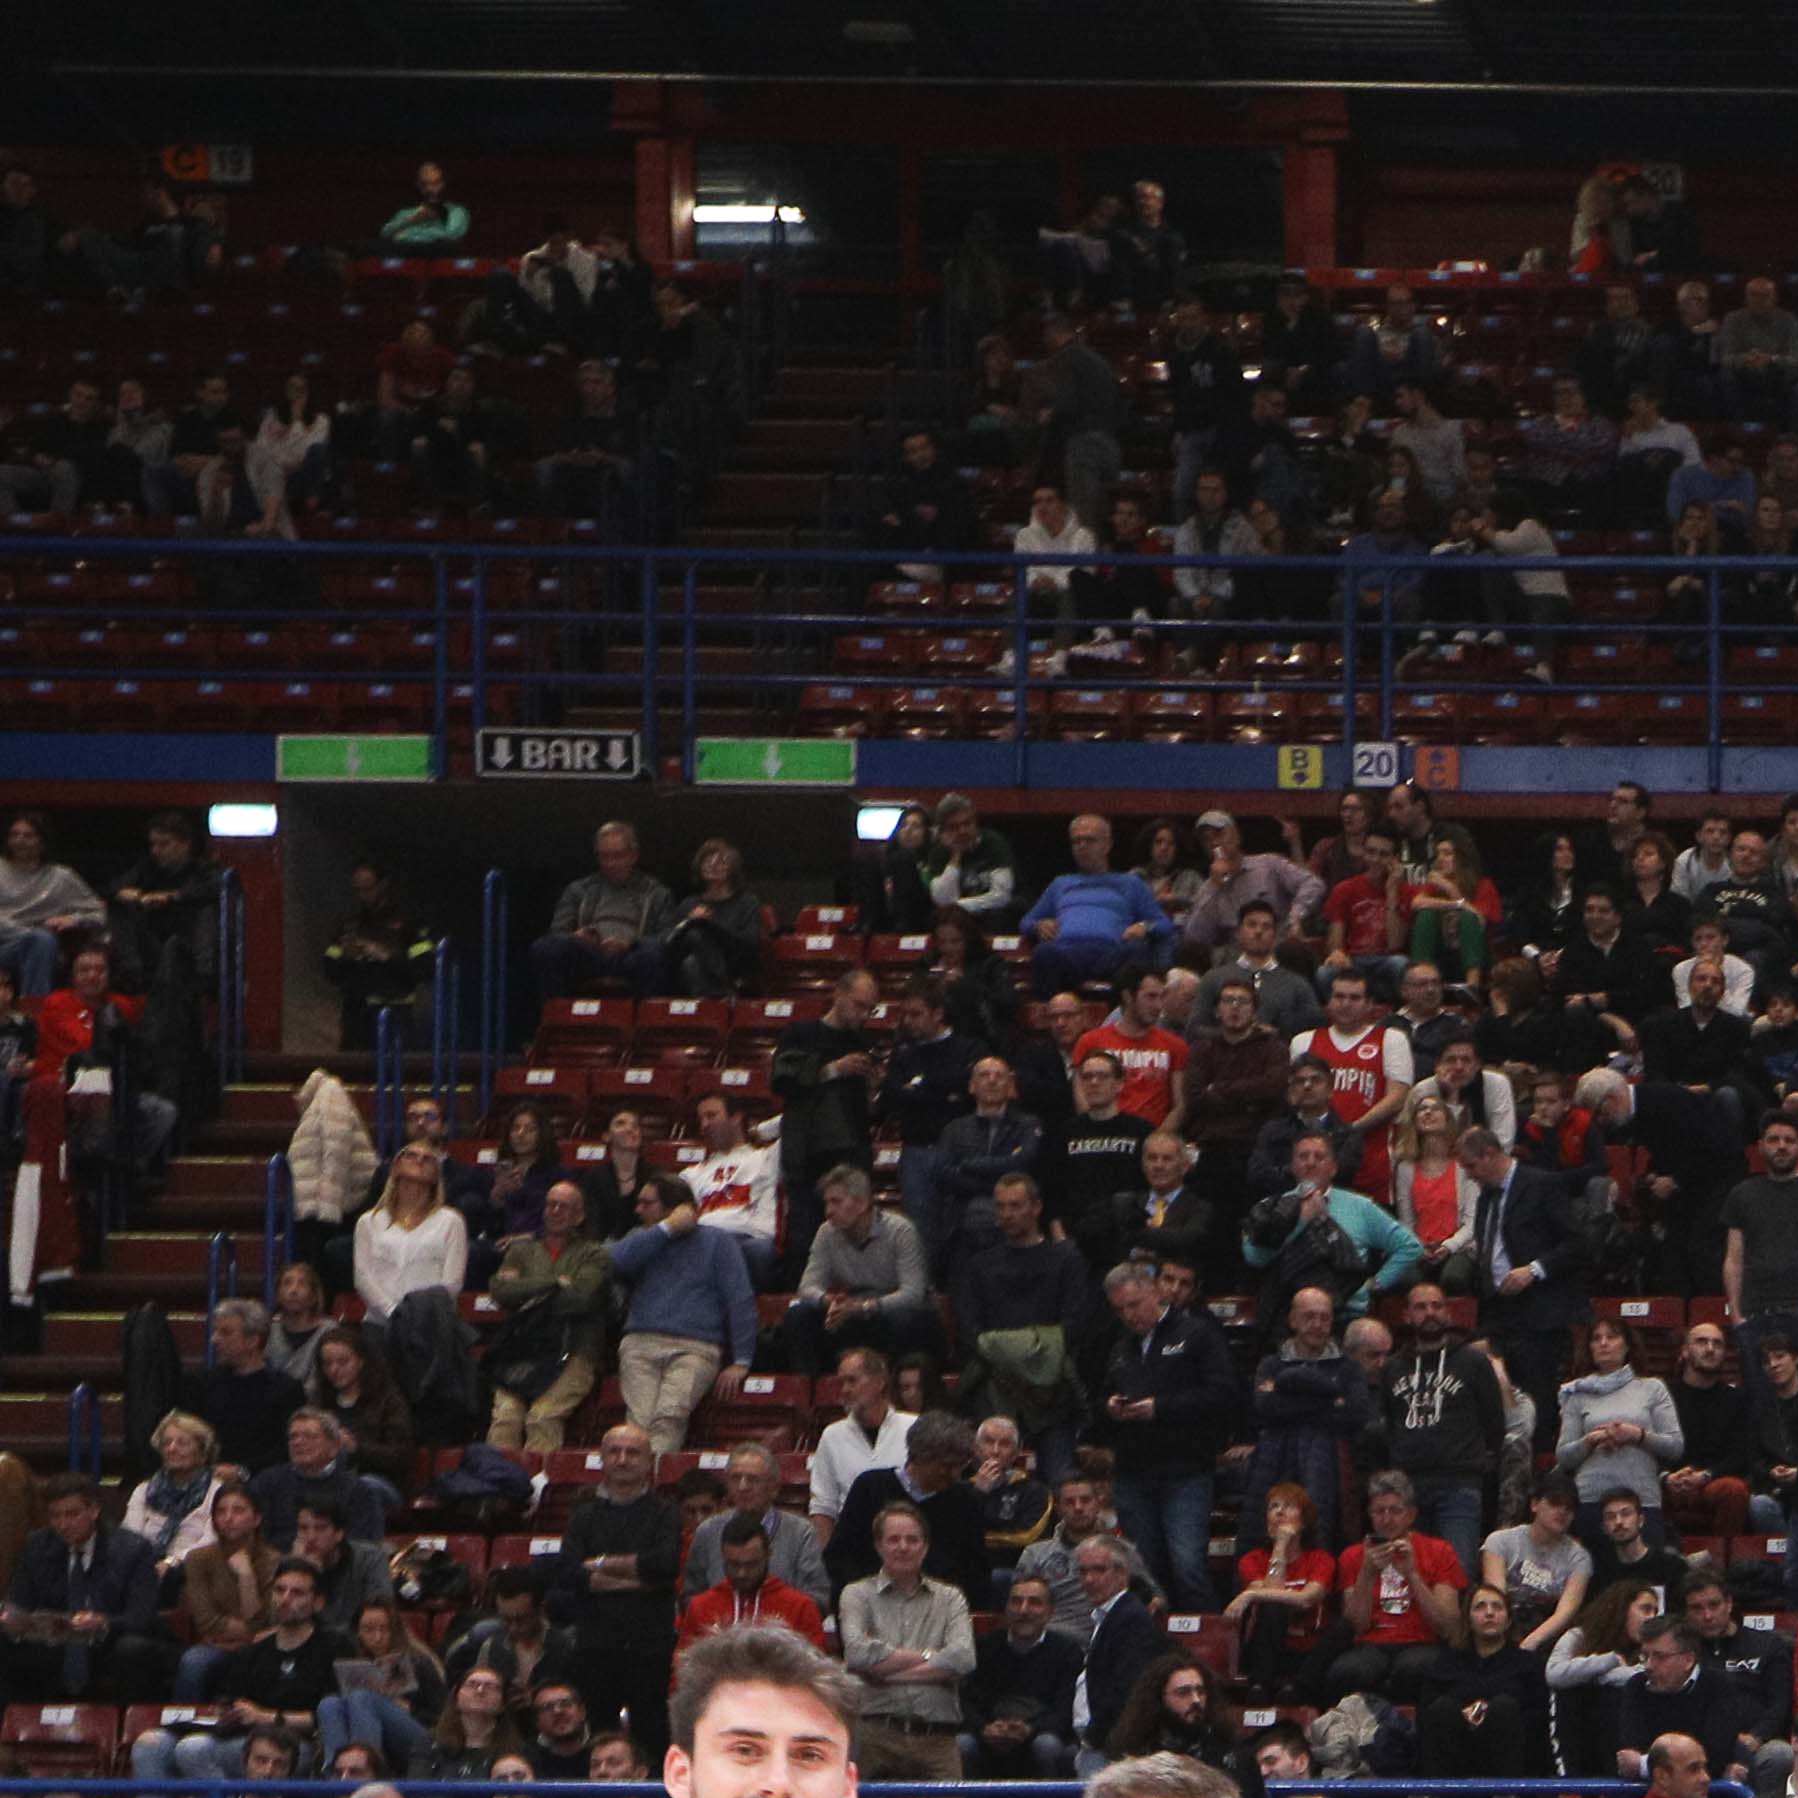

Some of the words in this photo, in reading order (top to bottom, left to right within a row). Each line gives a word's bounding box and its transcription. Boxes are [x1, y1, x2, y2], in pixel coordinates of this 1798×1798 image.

[522, 739, 601, 770] BAR
[1292, 746, 1308, 771] B
[1358, 751, 1394, 782] 20
[1430, 767, 1446, 785] C
[1068, 1138, 1137, 1154] CARHARTT
[1425, 1371, 1464, 1396] YORK
[1178, 1618, 1191, 1631] 10
[1754, 1617, 1767, 1630] 15
[1726, 1658, 1760, 1671] EA7
[1255, 1711, 1267, 1724] 11
